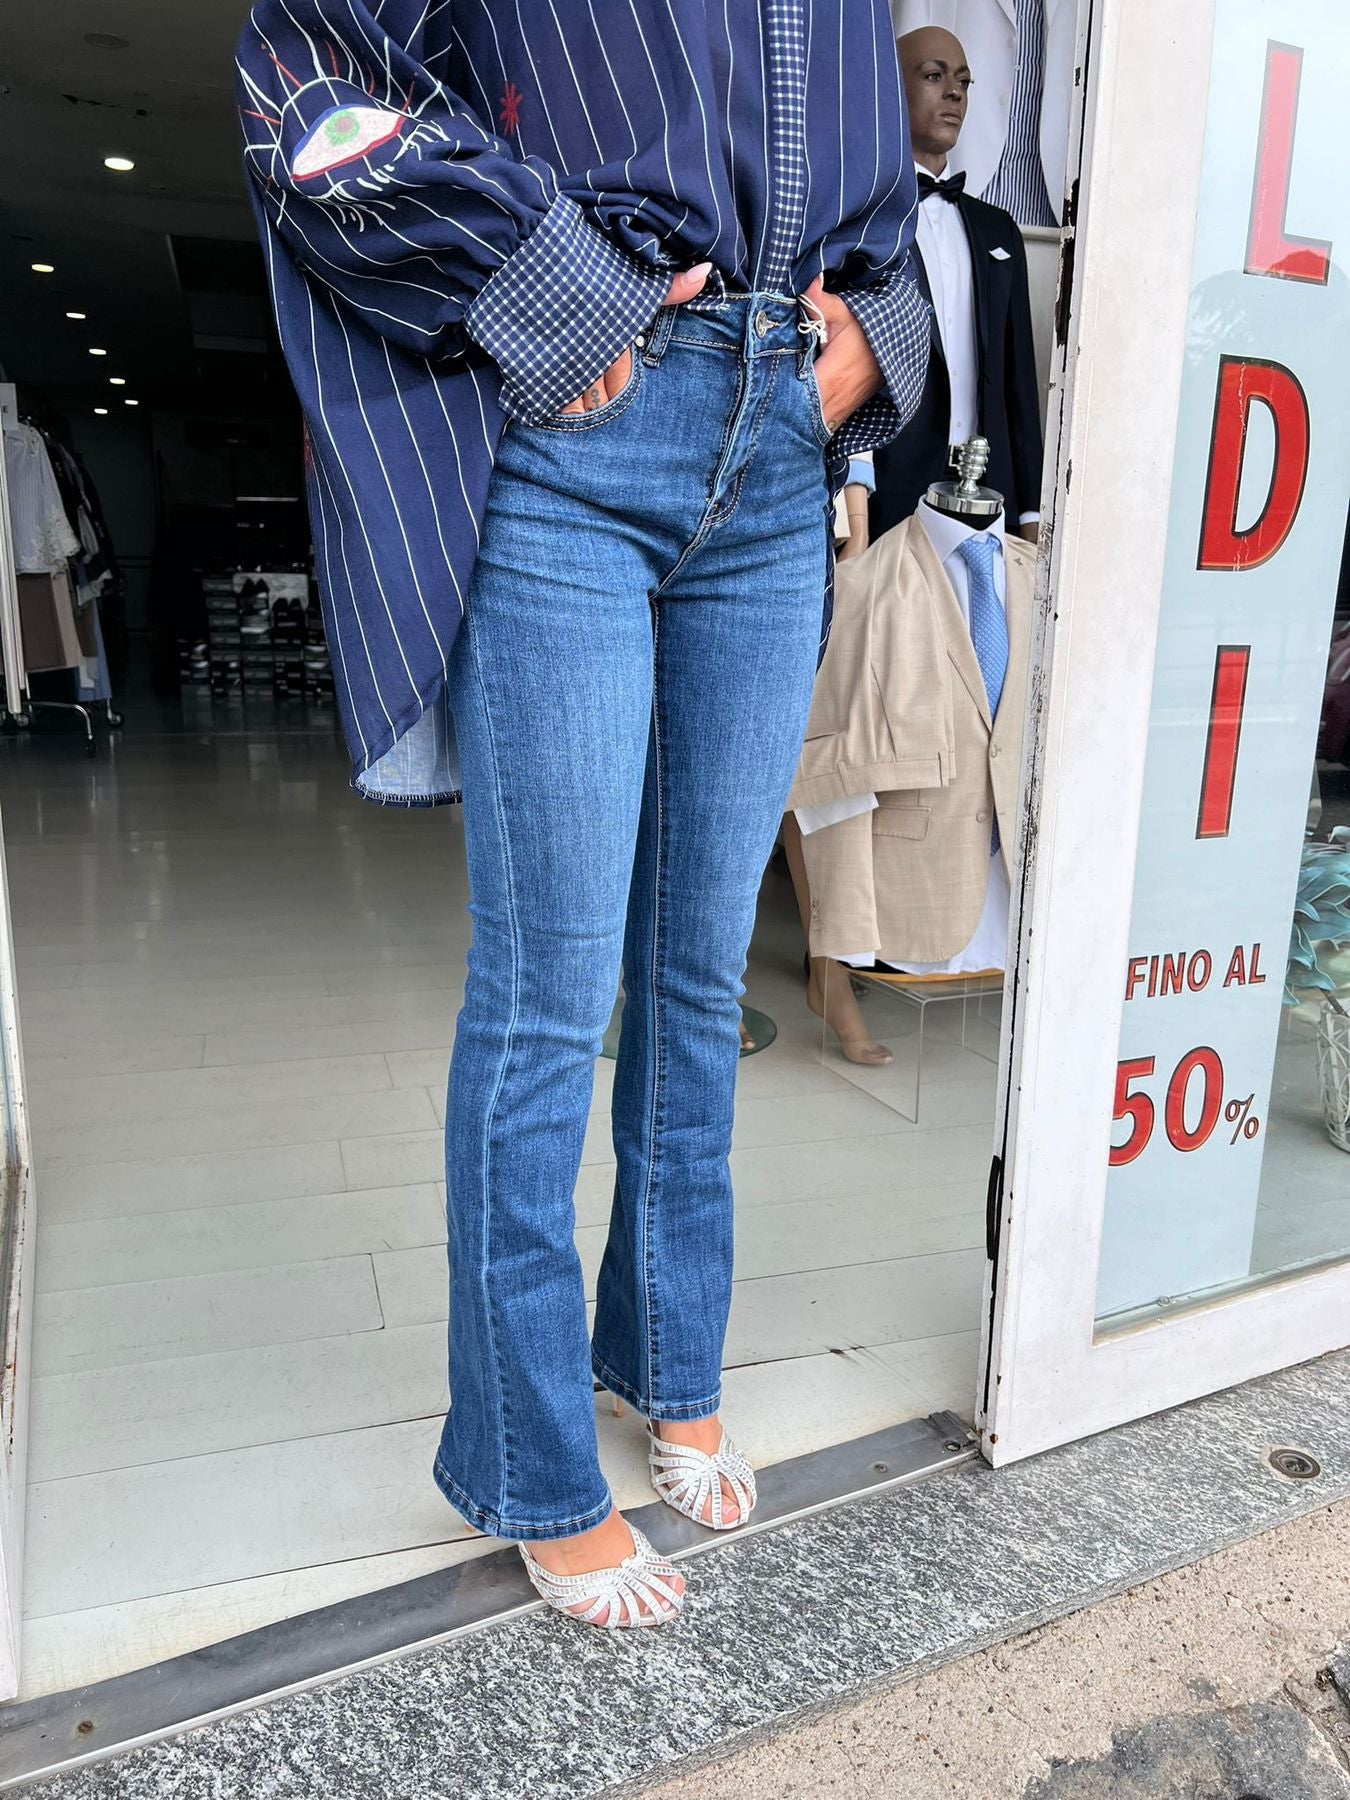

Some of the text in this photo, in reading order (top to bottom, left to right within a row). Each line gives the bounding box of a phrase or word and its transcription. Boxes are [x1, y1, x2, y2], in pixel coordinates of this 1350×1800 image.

[1125, 943, 1266, 1000] FINO AL
[1108, 1045, 1259, 1167] 50%
